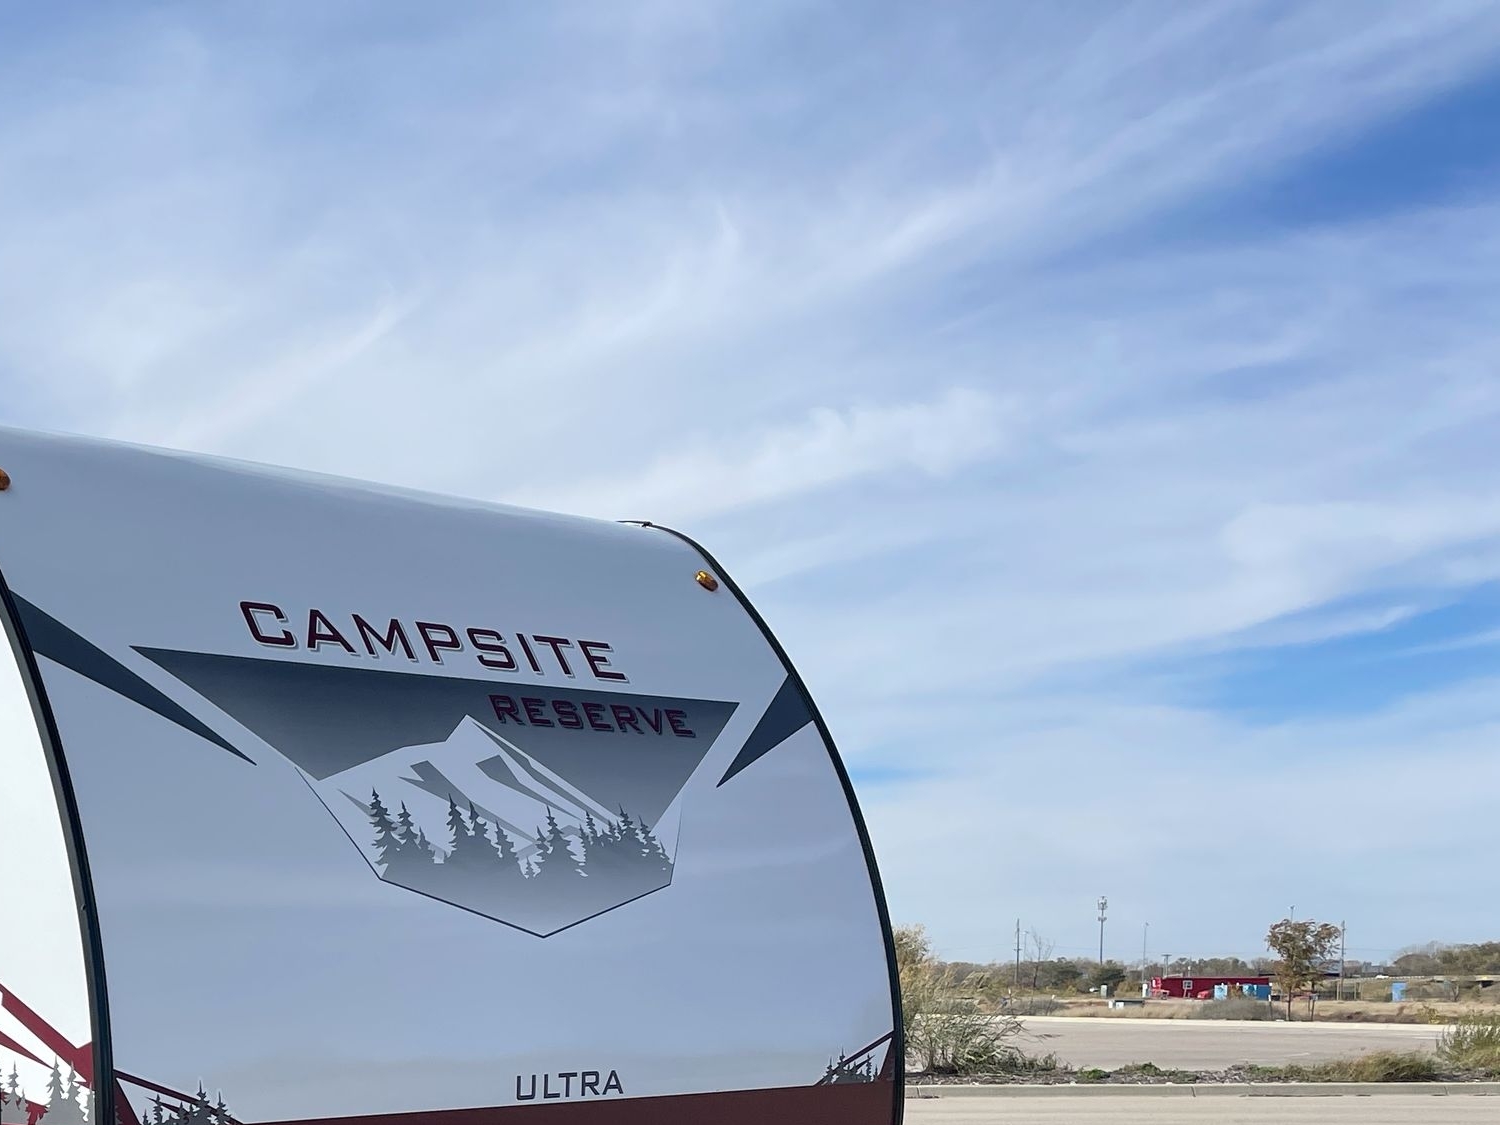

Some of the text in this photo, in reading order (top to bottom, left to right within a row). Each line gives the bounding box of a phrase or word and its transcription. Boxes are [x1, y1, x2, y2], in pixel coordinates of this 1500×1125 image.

[239, 600, 630, 683] CAMPSITE
[488, 694, 696, 739] RESERVE
[516, 1070, 624, 1101] ULTRA
